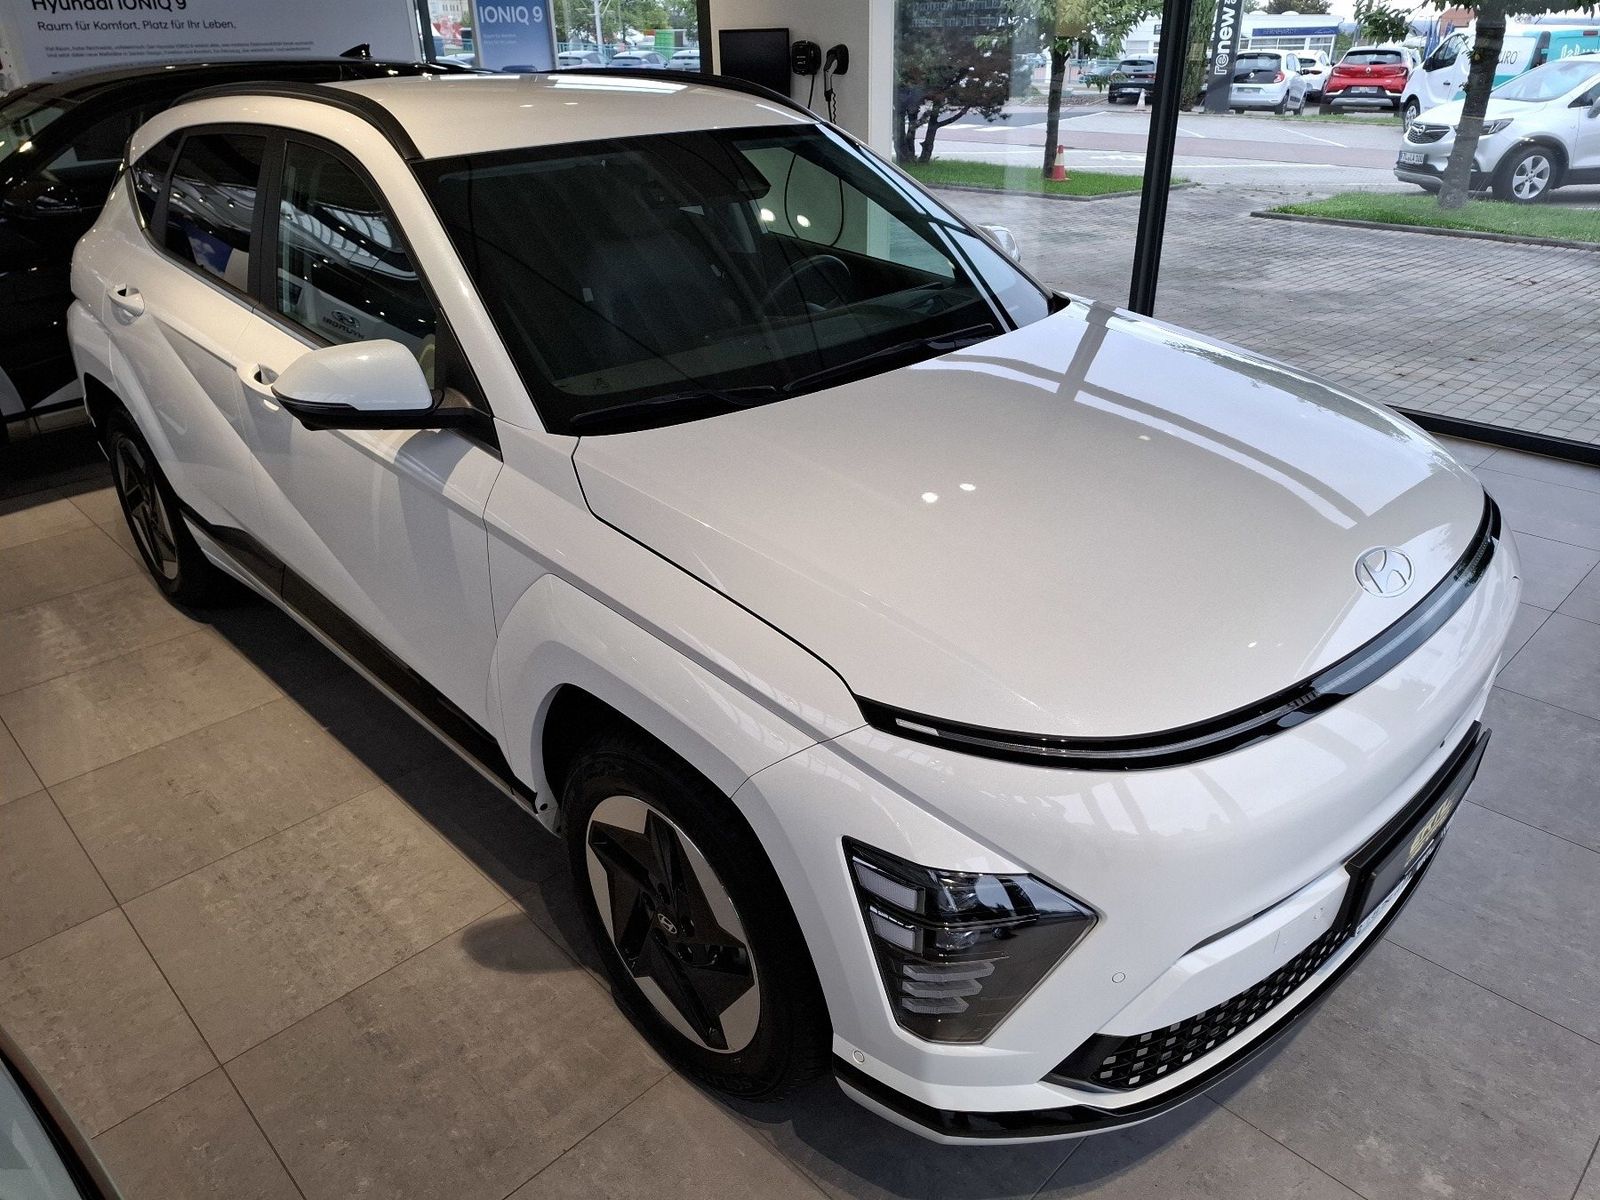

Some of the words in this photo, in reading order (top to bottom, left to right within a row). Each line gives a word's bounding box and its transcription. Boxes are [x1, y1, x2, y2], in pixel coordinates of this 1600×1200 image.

[32, 0, 113, 14] Hyundai
[118, 0, 172, 12] IONIQ
[176, 0, 187, 10] 9
[479, 6, 529, 25] IONIQ
[532, 6, 543, 22] 9
[37, 21, 73, 31] Raum
[75, 20, 90, 31] für
[93, 20, 140, 31] Komfort.
[142, 20, 168, 30] Platz
[171, 19, 185, 29] für
[187, 19, 200, 29] Ihr
[1214, 7, 1235, 75] renew
